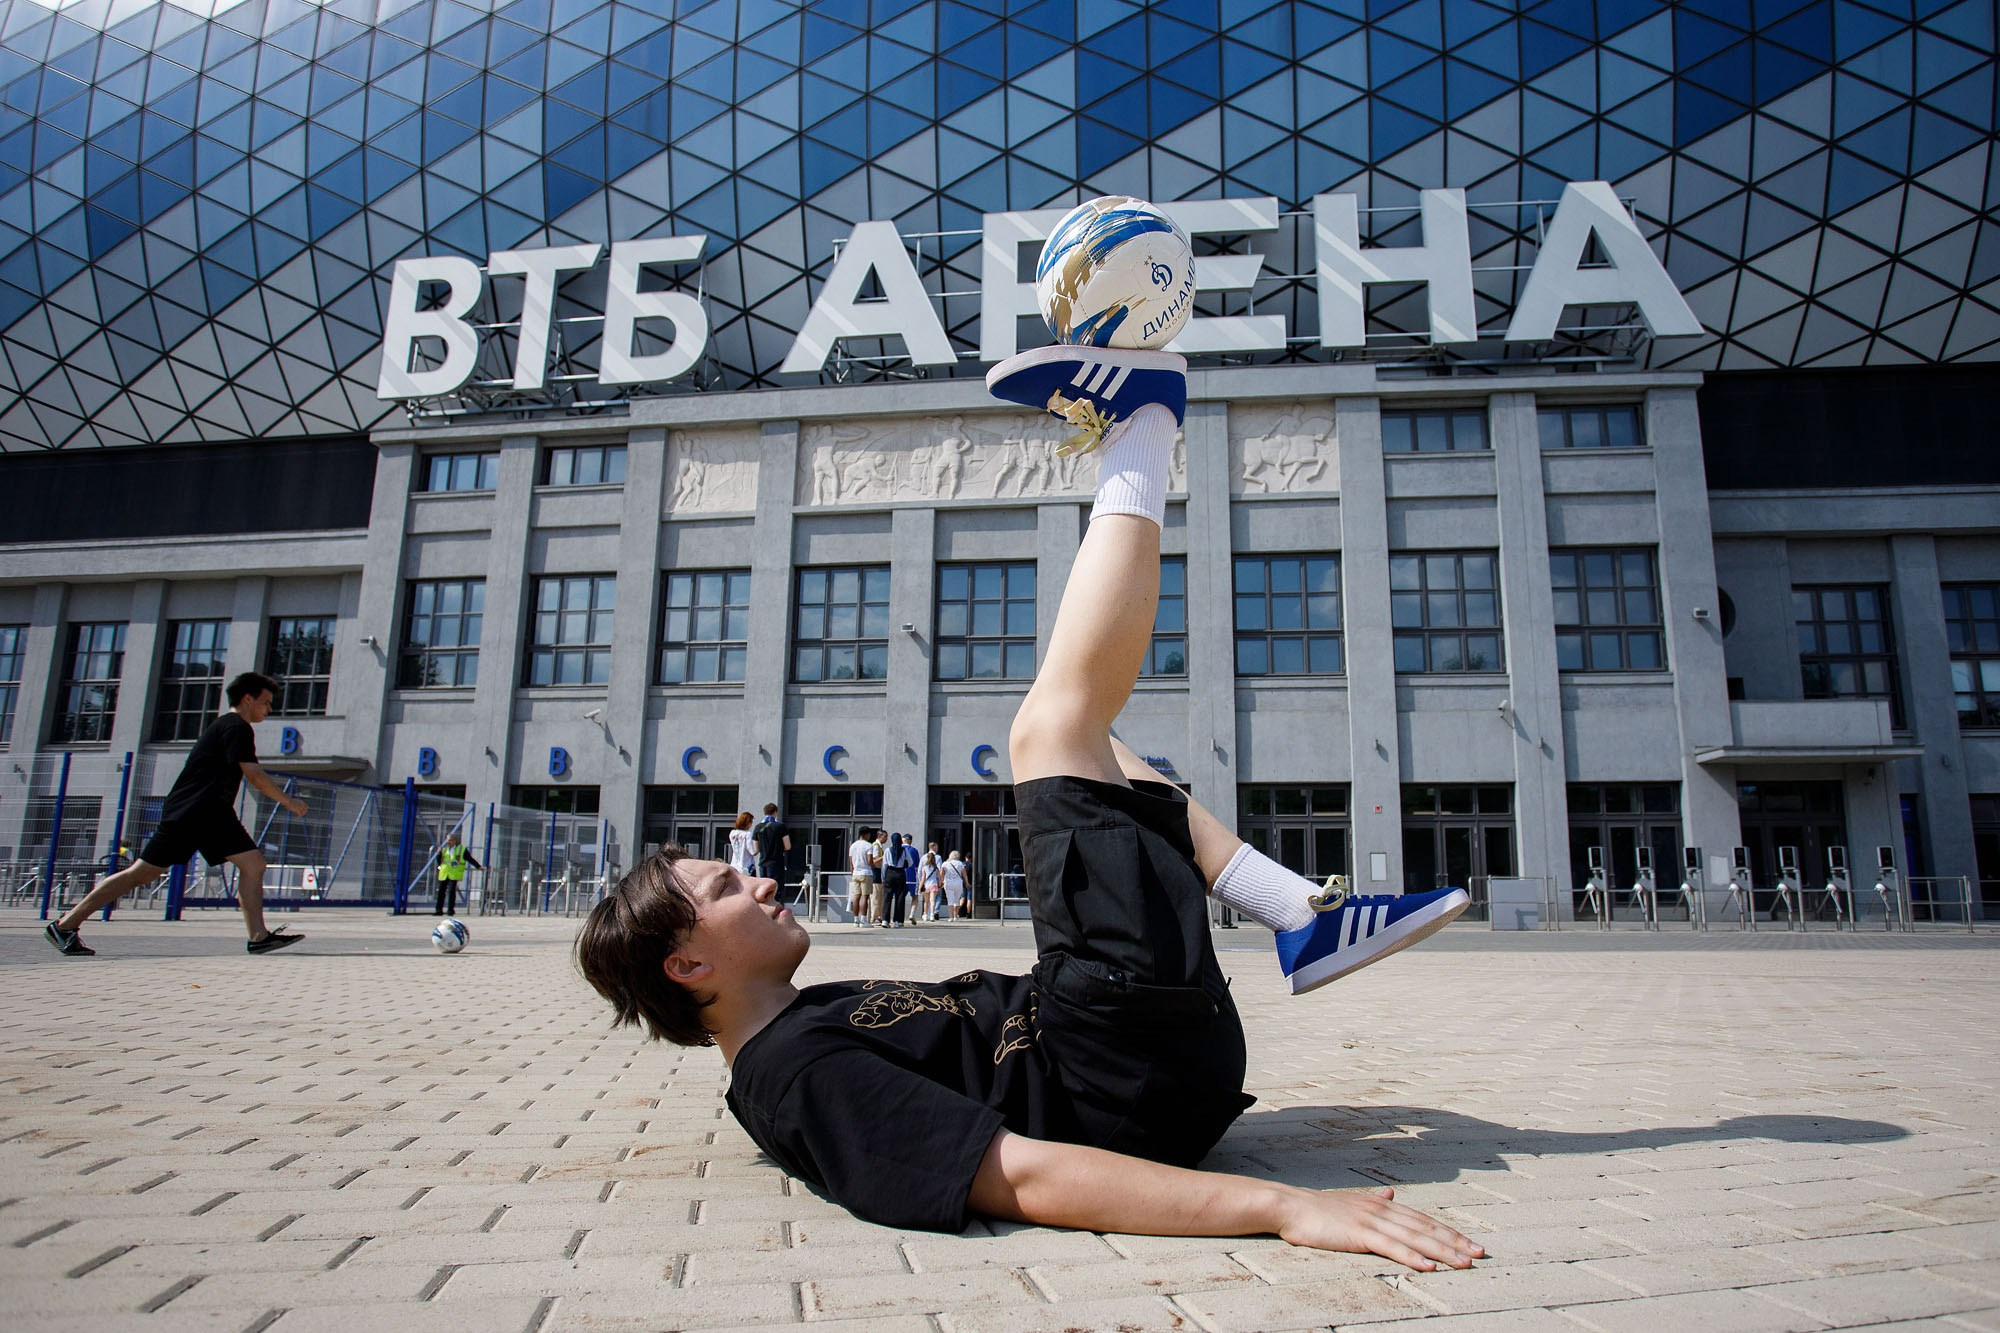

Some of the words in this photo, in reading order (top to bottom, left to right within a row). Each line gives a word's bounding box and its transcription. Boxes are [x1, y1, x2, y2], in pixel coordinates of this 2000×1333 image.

[1143, 256, 1196, 340] ДИНАМО
[377, 234, 709, 399] ВТБ
[681, 746, 704, 776] C
[823, 745, 845, 776] C
[971, 744, 993, 775] C
